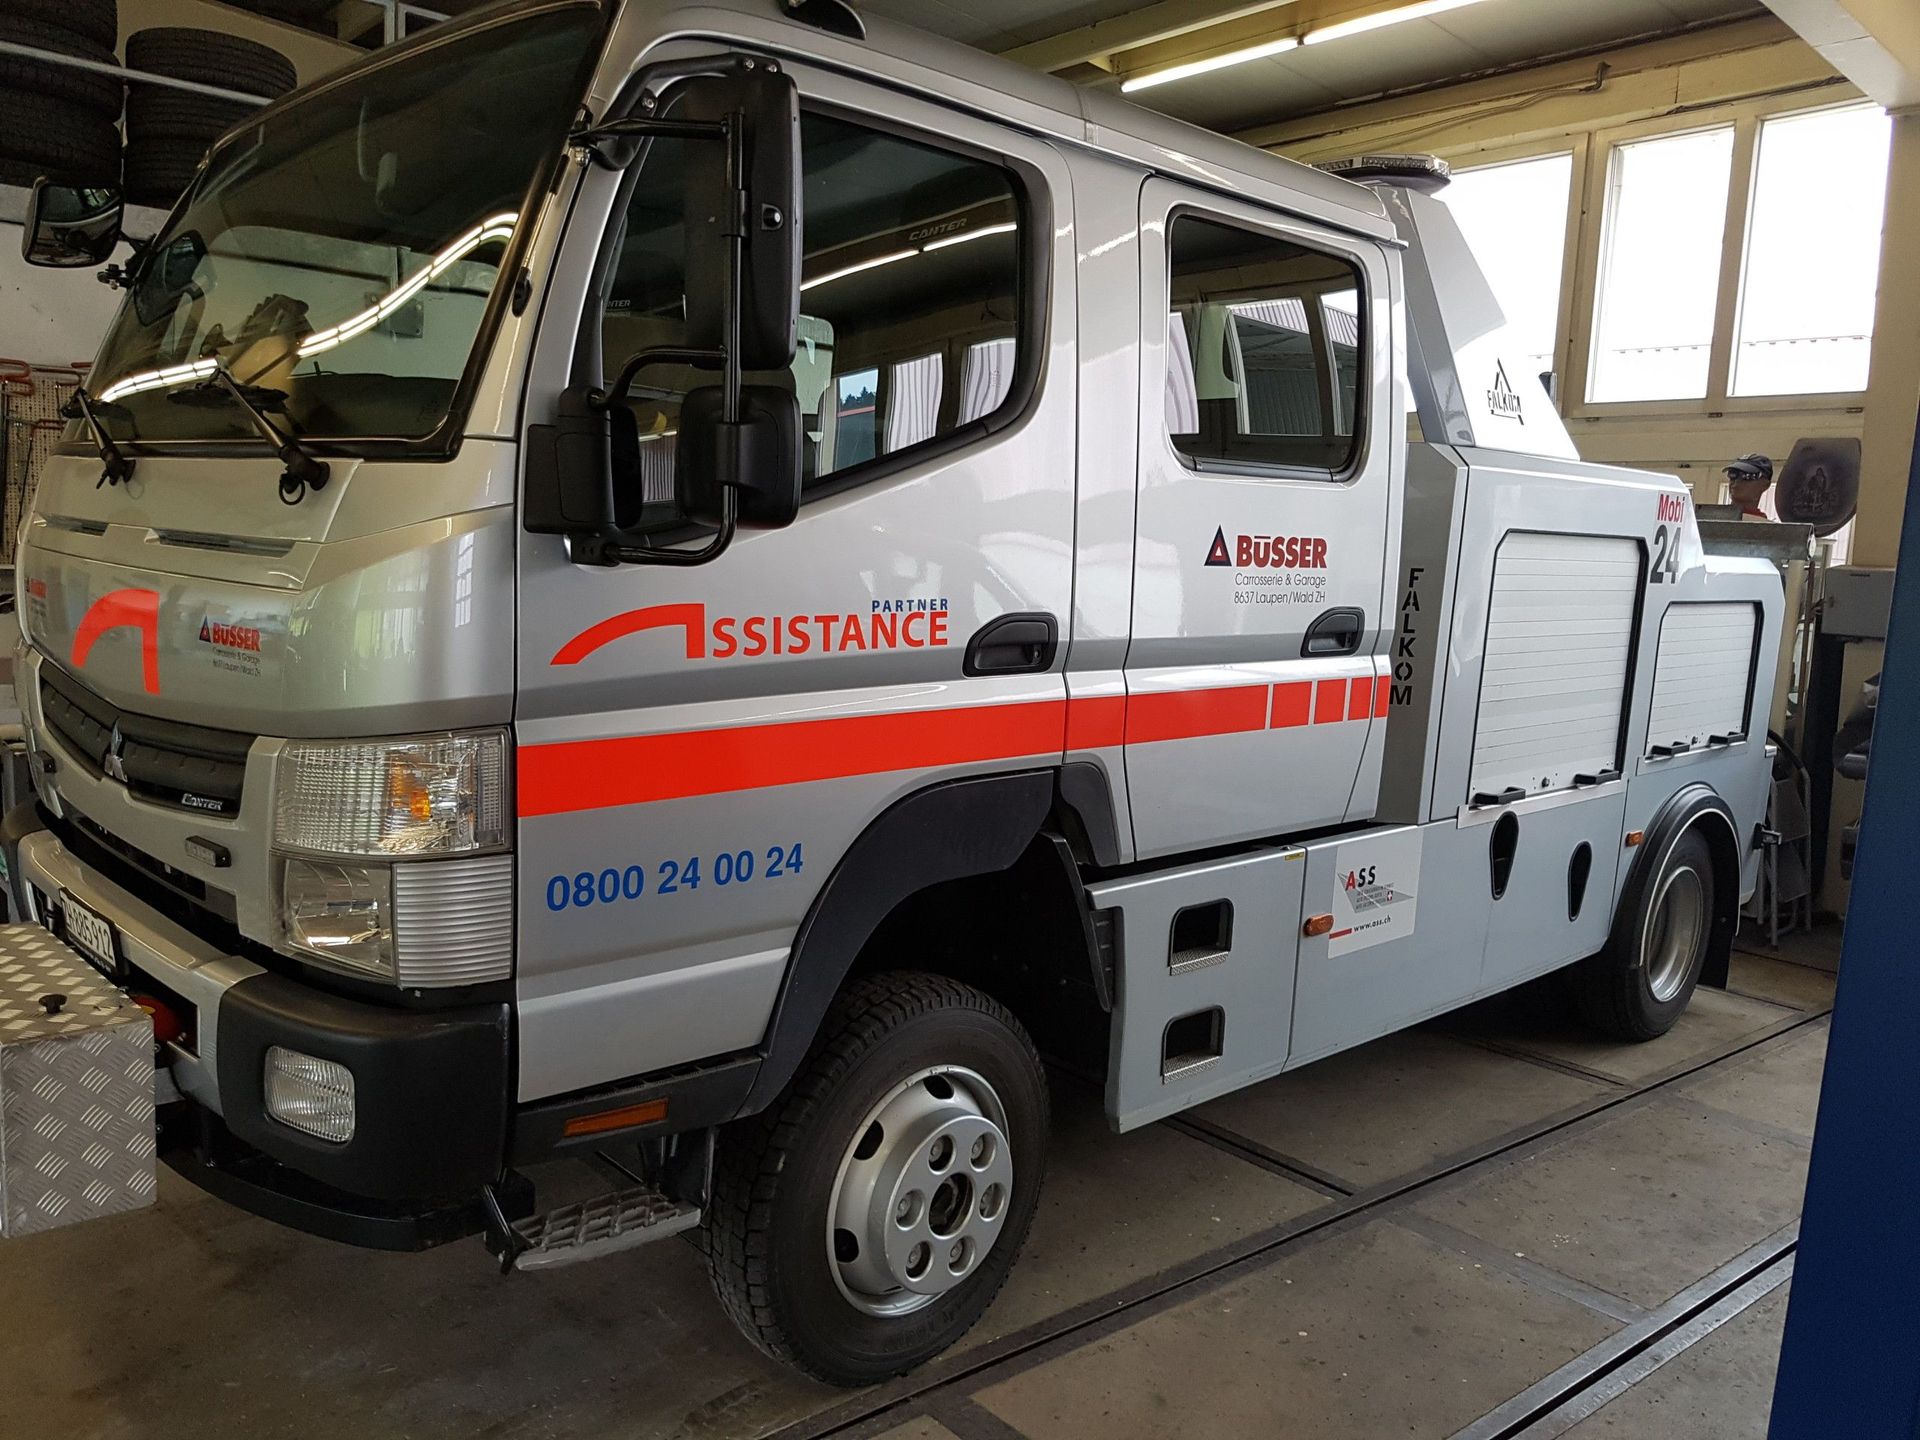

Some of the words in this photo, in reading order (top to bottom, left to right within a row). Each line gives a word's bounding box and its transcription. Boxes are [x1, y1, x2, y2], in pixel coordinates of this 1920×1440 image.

[909, 218, 968, 241] CANTER
[1657, 493, 1686, 523] Mobi
[1649, 524, 1682, 584] 24
[1235, 572, 1284, 587] Carrosserie
[1285, 573, 1292, 587] &
[1294, 573, 1327, 589] Garage
[871, 598, 949, 612] PARTNER
[1234, 591, 1255, 604] 8637
[1255, 590, 1315, 606] Laupen/Wald
[1315, 590, 1326, 604] ZH
[1389, 567, 1425, 706] FALKOM
[546, 865, 645, 912] 0800
[657, 856, 701, 895] 24
[713, 850, 755, 886] 00
[765, 842, 804, 878] 24
[1345, 865, 1376, 892] ASS
[1353, 914, 1391, 932] www.ass.ch
